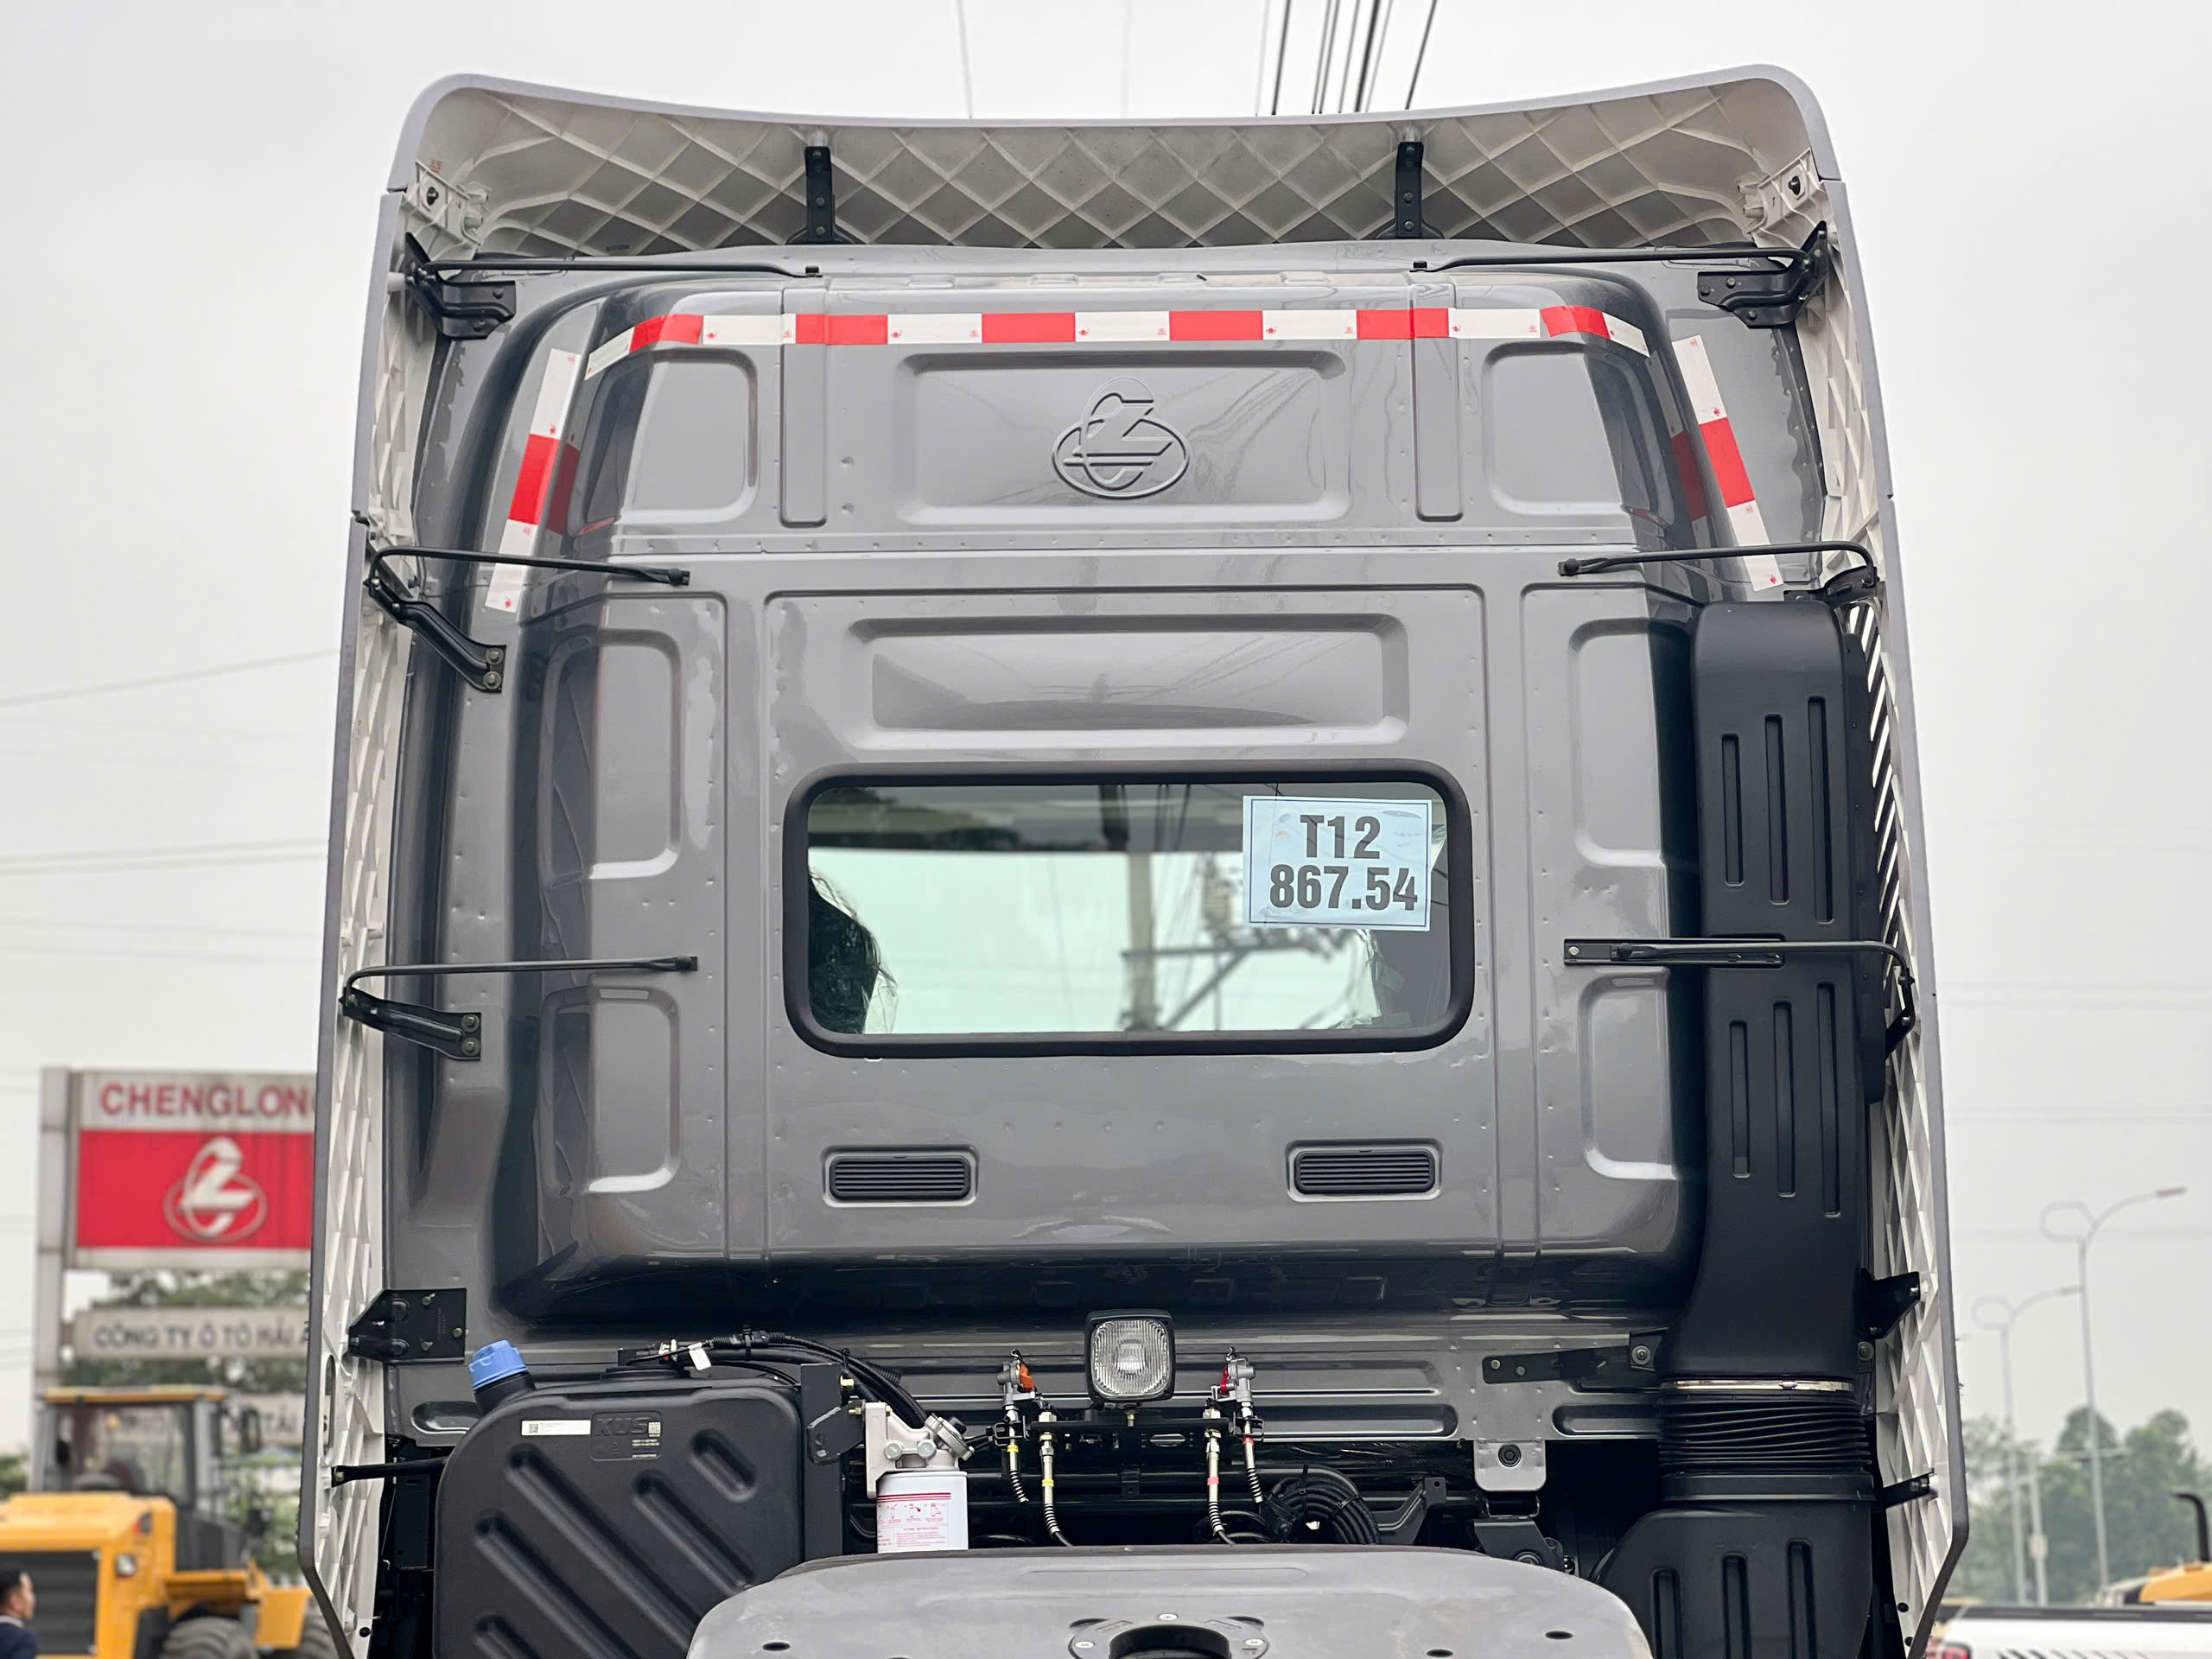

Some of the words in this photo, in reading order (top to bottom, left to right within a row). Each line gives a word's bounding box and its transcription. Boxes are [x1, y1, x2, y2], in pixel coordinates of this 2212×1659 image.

[1300, 814, 1381, 860] T12
[1269, 864, 1418, 912] 867.54
[99, 1082, 315, 1116] CHENGLON
